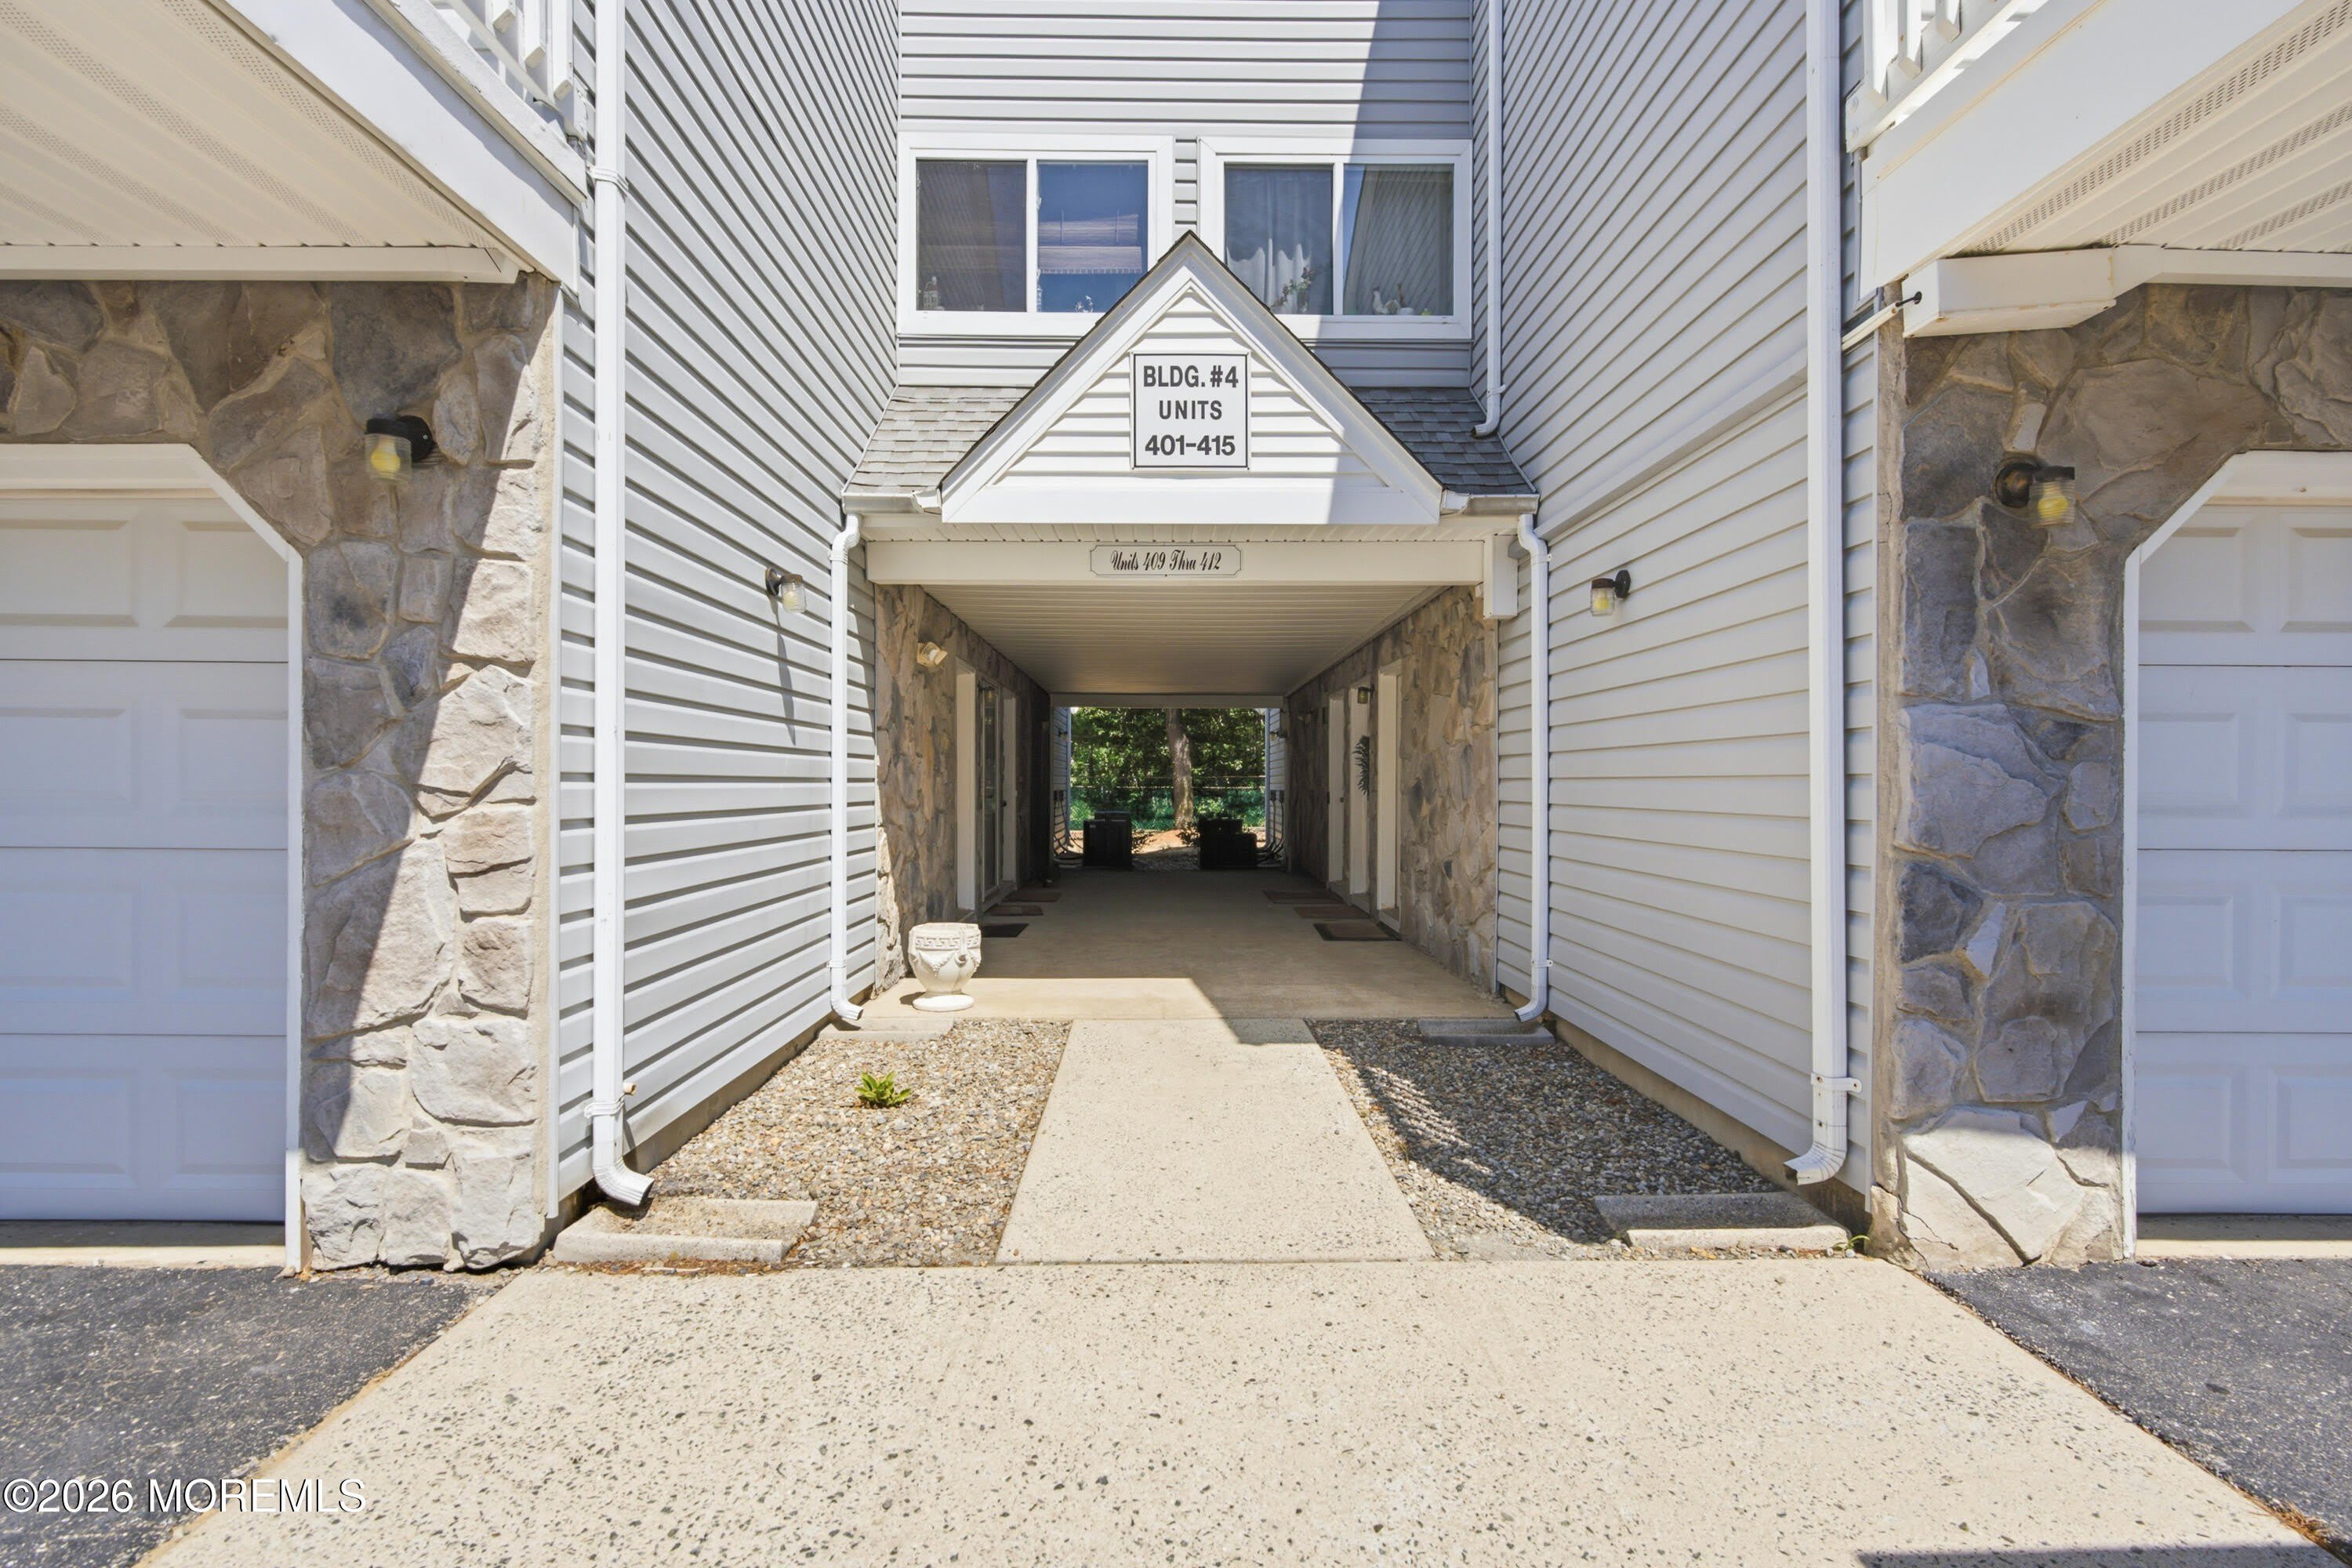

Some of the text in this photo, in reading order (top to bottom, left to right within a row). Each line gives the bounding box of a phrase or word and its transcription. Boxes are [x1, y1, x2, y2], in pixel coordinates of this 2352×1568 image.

[1143, 365, 1239, 388] BLDG. #4
[1159, 400, 1222, 420] UNITS
[1145, 434, 1236, 456] 401-415
[1110, 549, 1222, 571] Units 409 Thru 412
